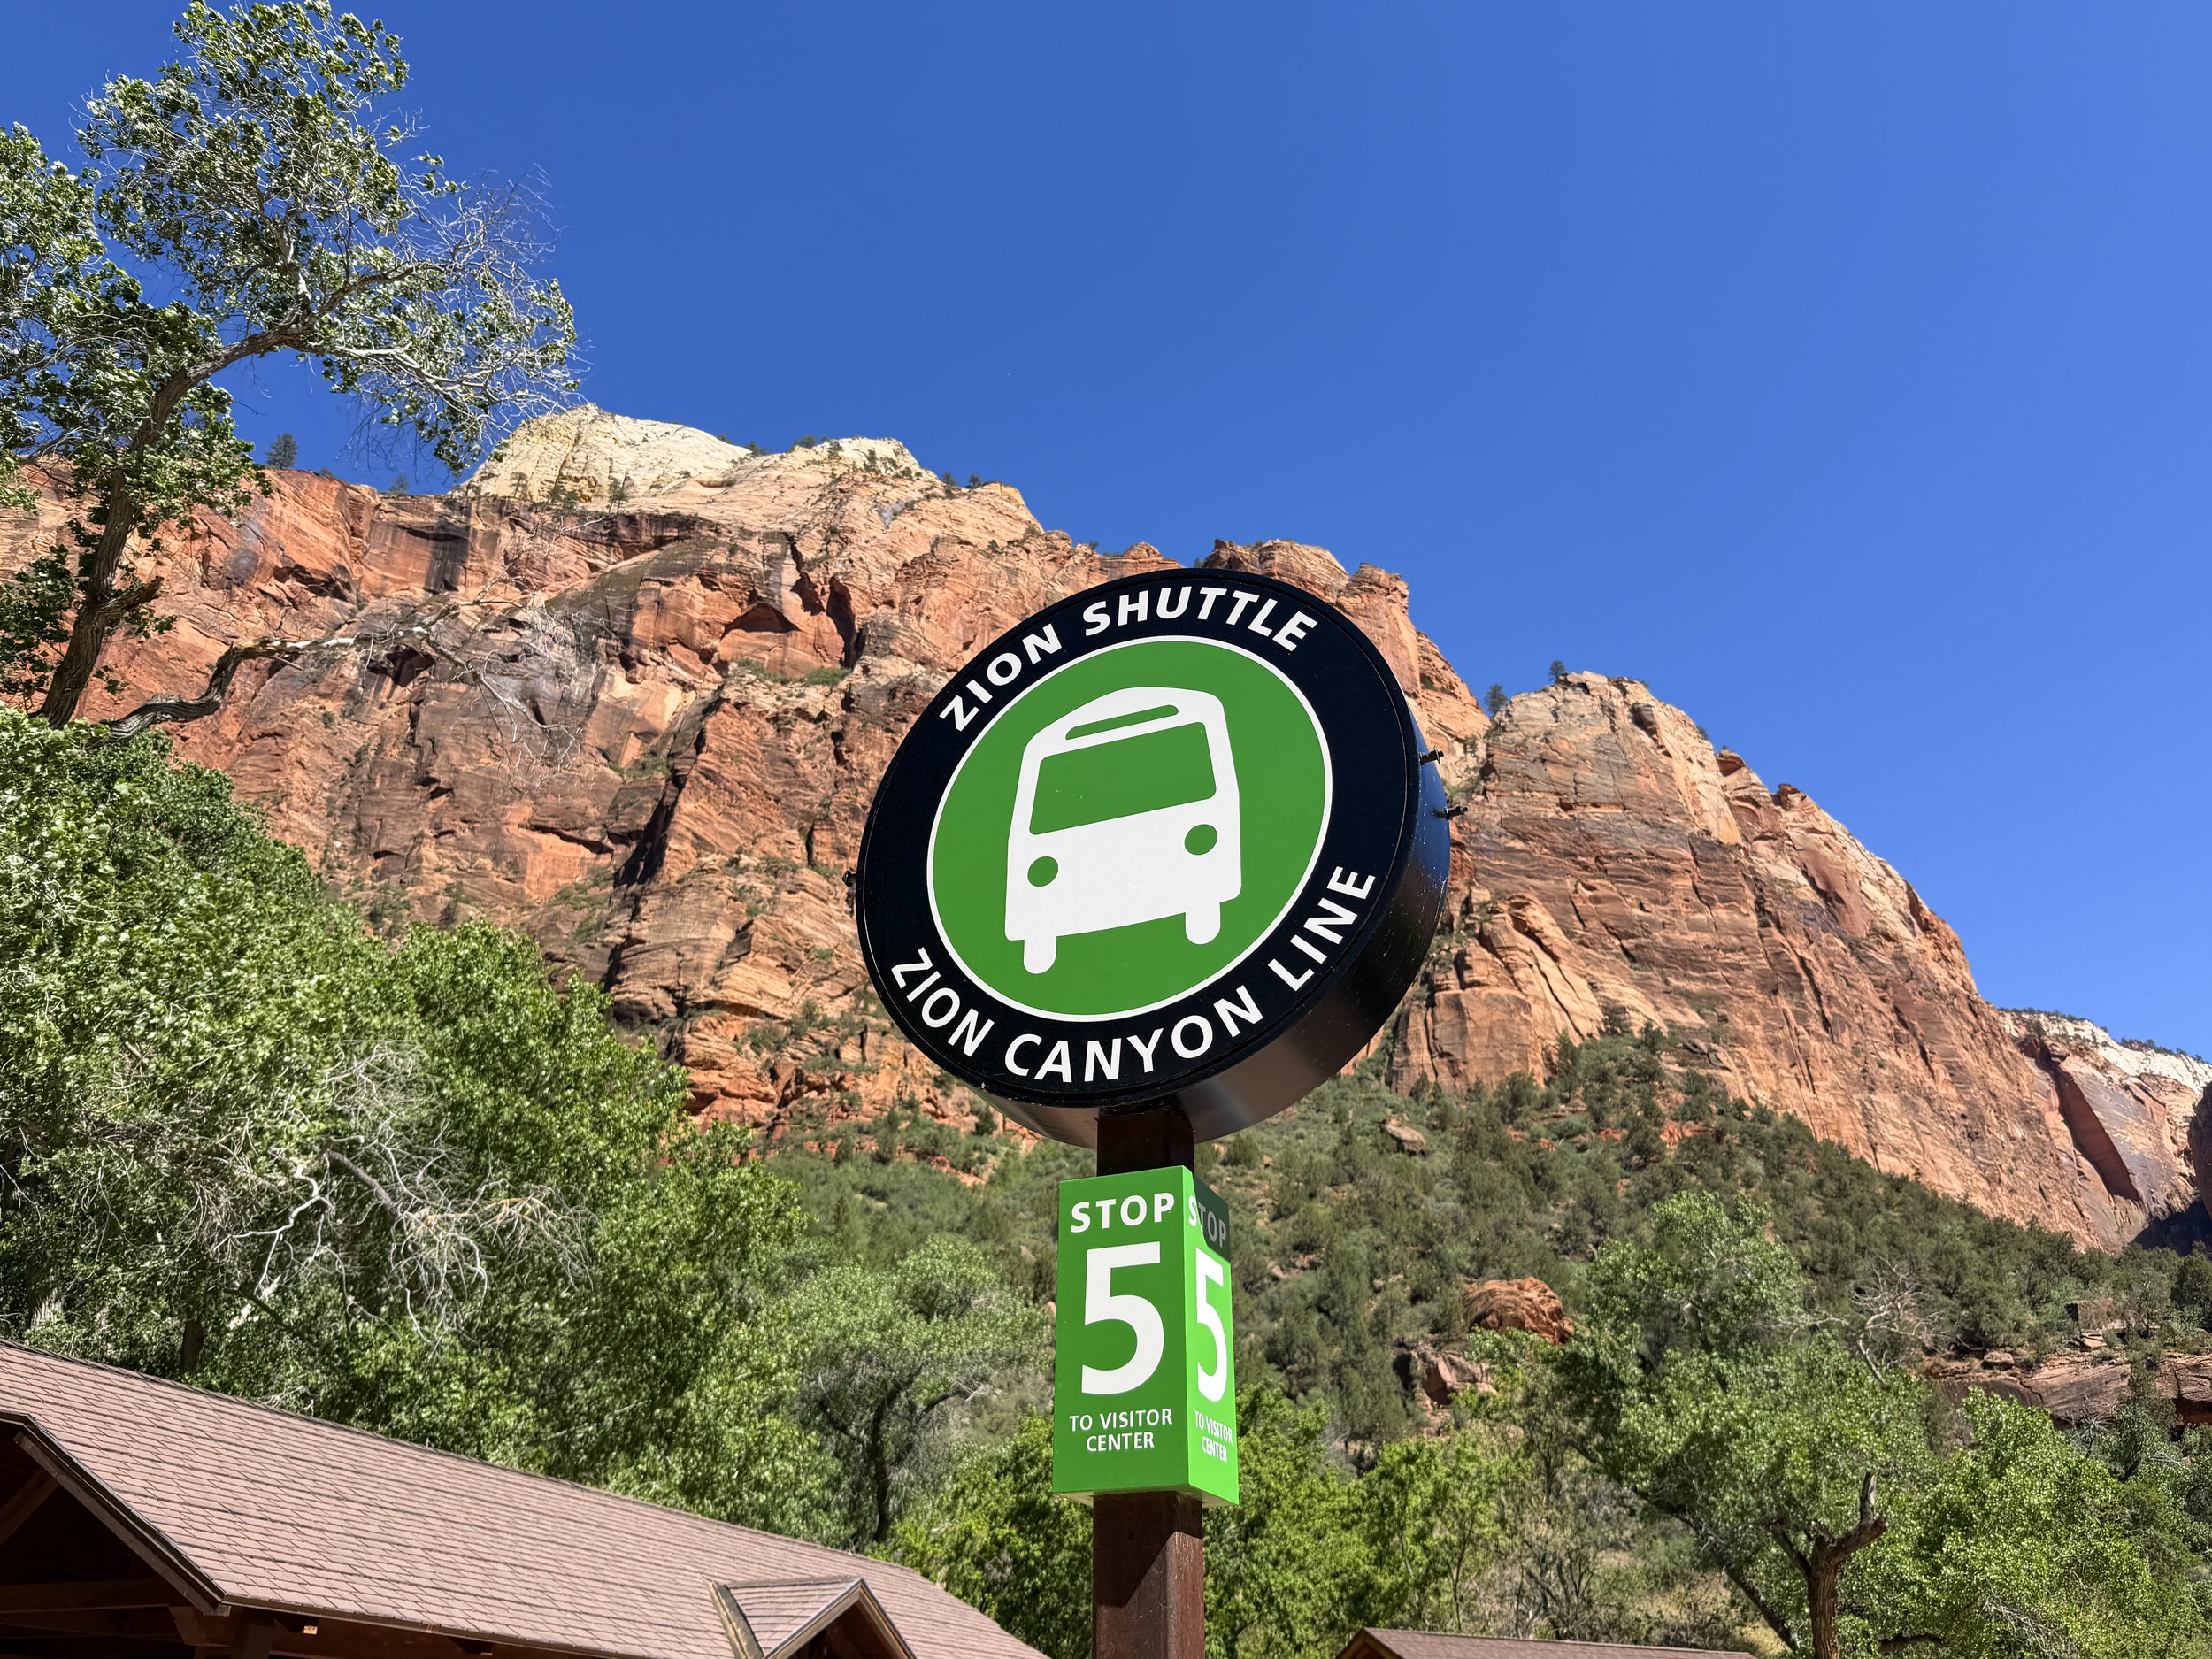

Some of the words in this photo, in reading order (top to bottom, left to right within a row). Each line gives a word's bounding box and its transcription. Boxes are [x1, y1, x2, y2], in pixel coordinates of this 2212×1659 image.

[939, 625, 1062, 733] ZION
[1082, 585, 1318, 653] SHUTTLE
[890, 947, 995, 1057] ZION
[1004, 986, 1264, 1084] CANYON
[1268, 864, 1377, 992] LINE
[1070, 1192, 1175, 1233] STOP
[1188, 1195, 1227, 1248] STOP
[1080, 1240, 1164, 1395] 5
[1194, 1246, 1228, 1402] 5
[1069, 1413, 1094, 1432] TO
[1099, 1408, 1173, 1429] VISITOR
[1085, 1432, 1156, 1452] CENTER
[1194, 1409, 1204, 1431] TO
[1206, 1416, 1233, 1446] VISITOR
[1202, 1435, 1228, 1463] CENTER
